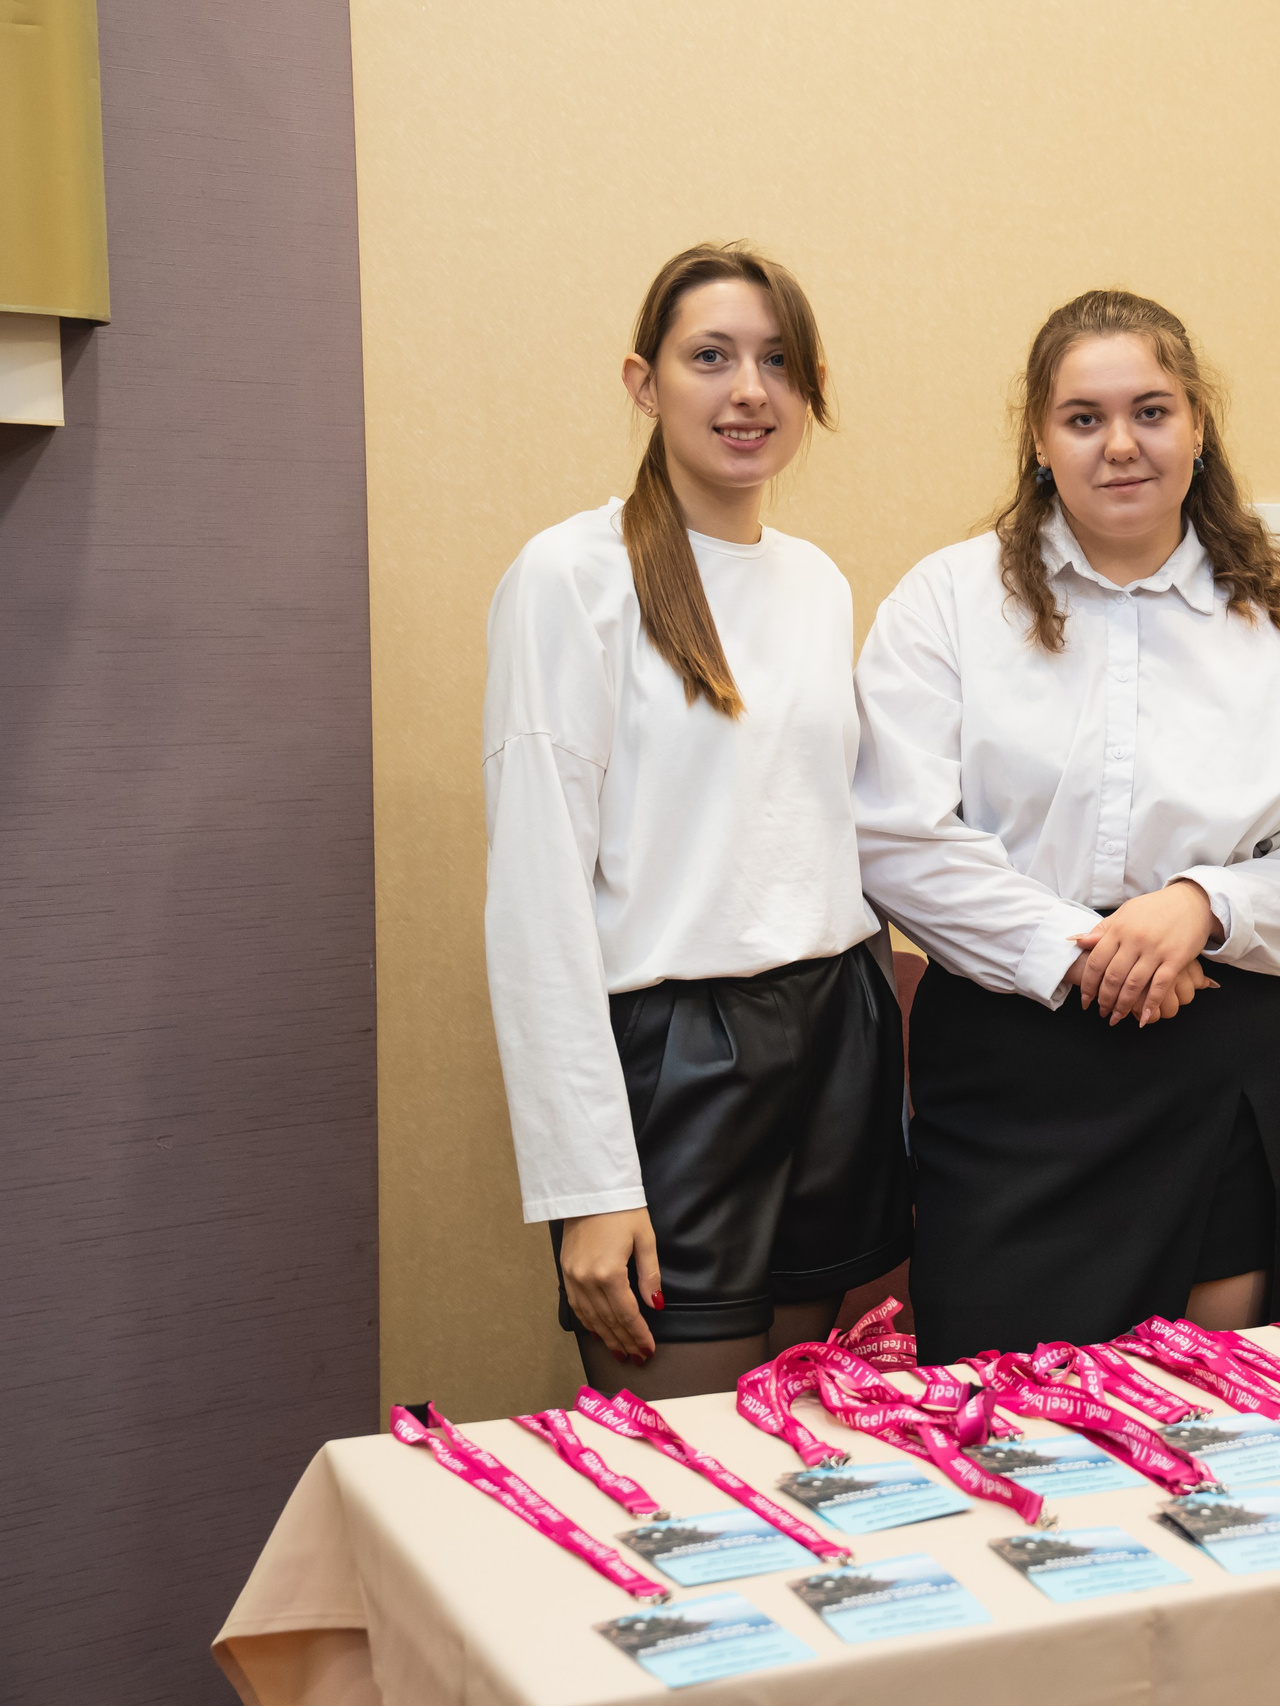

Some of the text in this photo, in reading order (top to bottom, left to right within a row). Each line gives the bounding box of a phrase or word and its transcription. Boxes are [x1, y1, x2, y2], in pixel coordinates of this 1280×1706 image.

[1150, 1320, 1176, 1339] bette
[1168, 1333, 1194, 1351] feel
[826, 1350, 856, 1373] feel
[1046, 1396, 1074, 1415] feel
[1234, 1387, 1260, 1411] medi.
[600, 1409, 625, 1427] feel
[854, 1410, 883, 1427] feel
[1082, 1401, 1112, 1423] medi.
